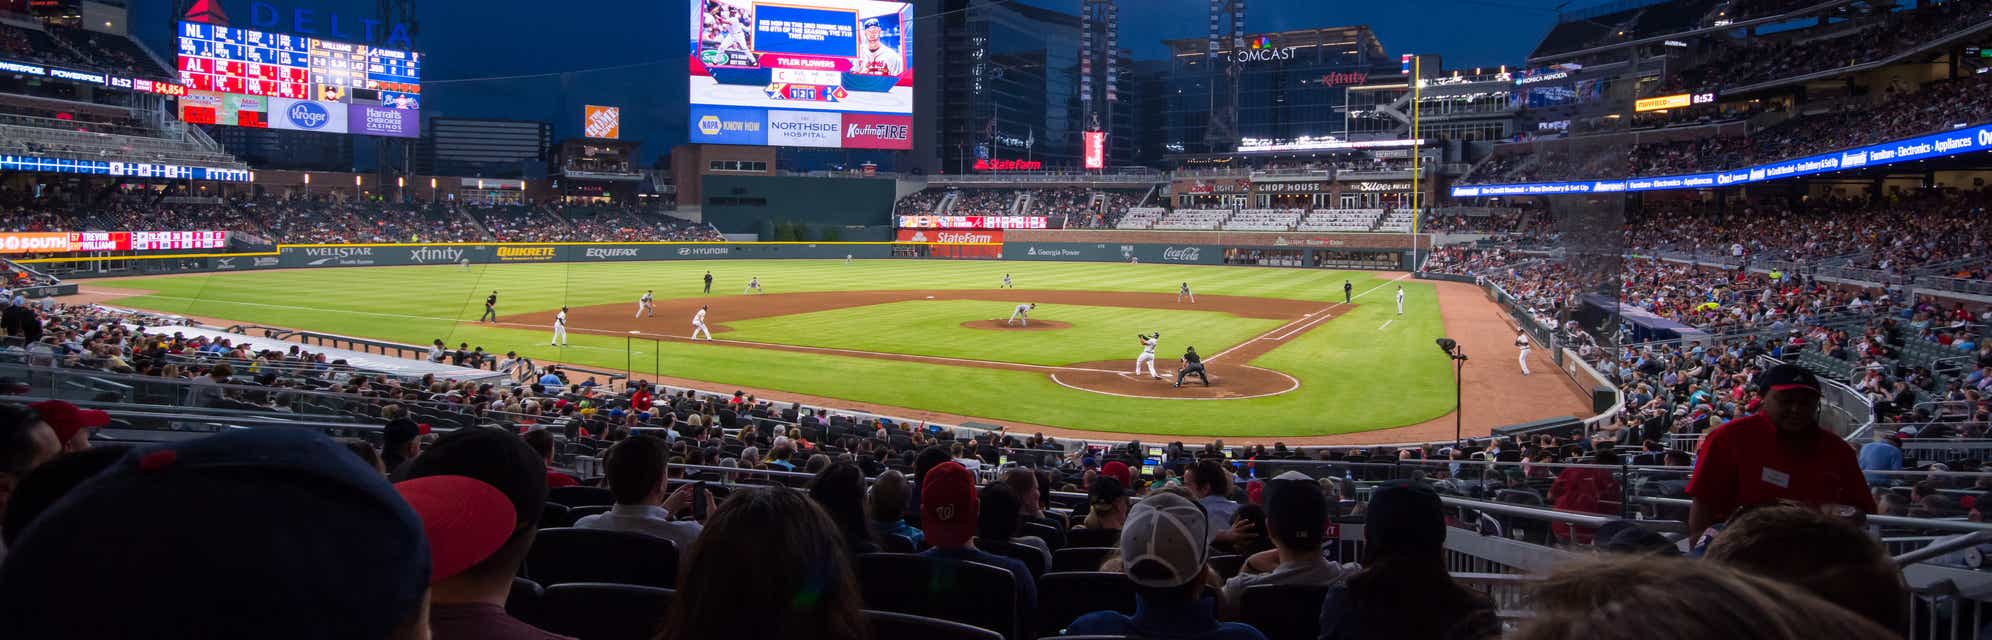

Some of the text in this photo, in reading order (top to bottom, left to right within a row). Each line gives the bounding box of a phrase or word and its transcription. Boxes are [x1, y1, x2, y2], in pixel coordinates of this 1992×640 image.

[251, 2, 411, 46] DELTA
[186, 24, 203, 38] NL
[322, 42, 351, 52] WILLIAMS
[187, 58, 203, 71] AL
[111, 77, 131, 88] 8:52
[156, 83, 184, 95] $4,854
[1694, 93, 1713, 103] 8:52
[292, 105, 328, 127] Kroger
[702, 118, 760, 132] NAPA KNOW HOW
[771, 122, 839, 132] NORTHSIDE
[876, 125, 907, 139] TIRE
[1898, 143, 1931, 158] Electronics
[1935, 136, 1972, 152] Appliances
[1287, 183, 1320, 191] HOUSE
[21, 237, 66, 249] SOUTH
[82, 241, 116, 249] WILLIAMS
[306, 247, 372, 257] WELLSTAR
[410, 247, 463, 263] xfinity
[497, 247, 555, 257] QUIKRETE
[586, 247, 638, 258] EQUIFAX
[692, 247, 728, 255] HYUNDAI
[1038, 249, 1060, 257] Georgia
